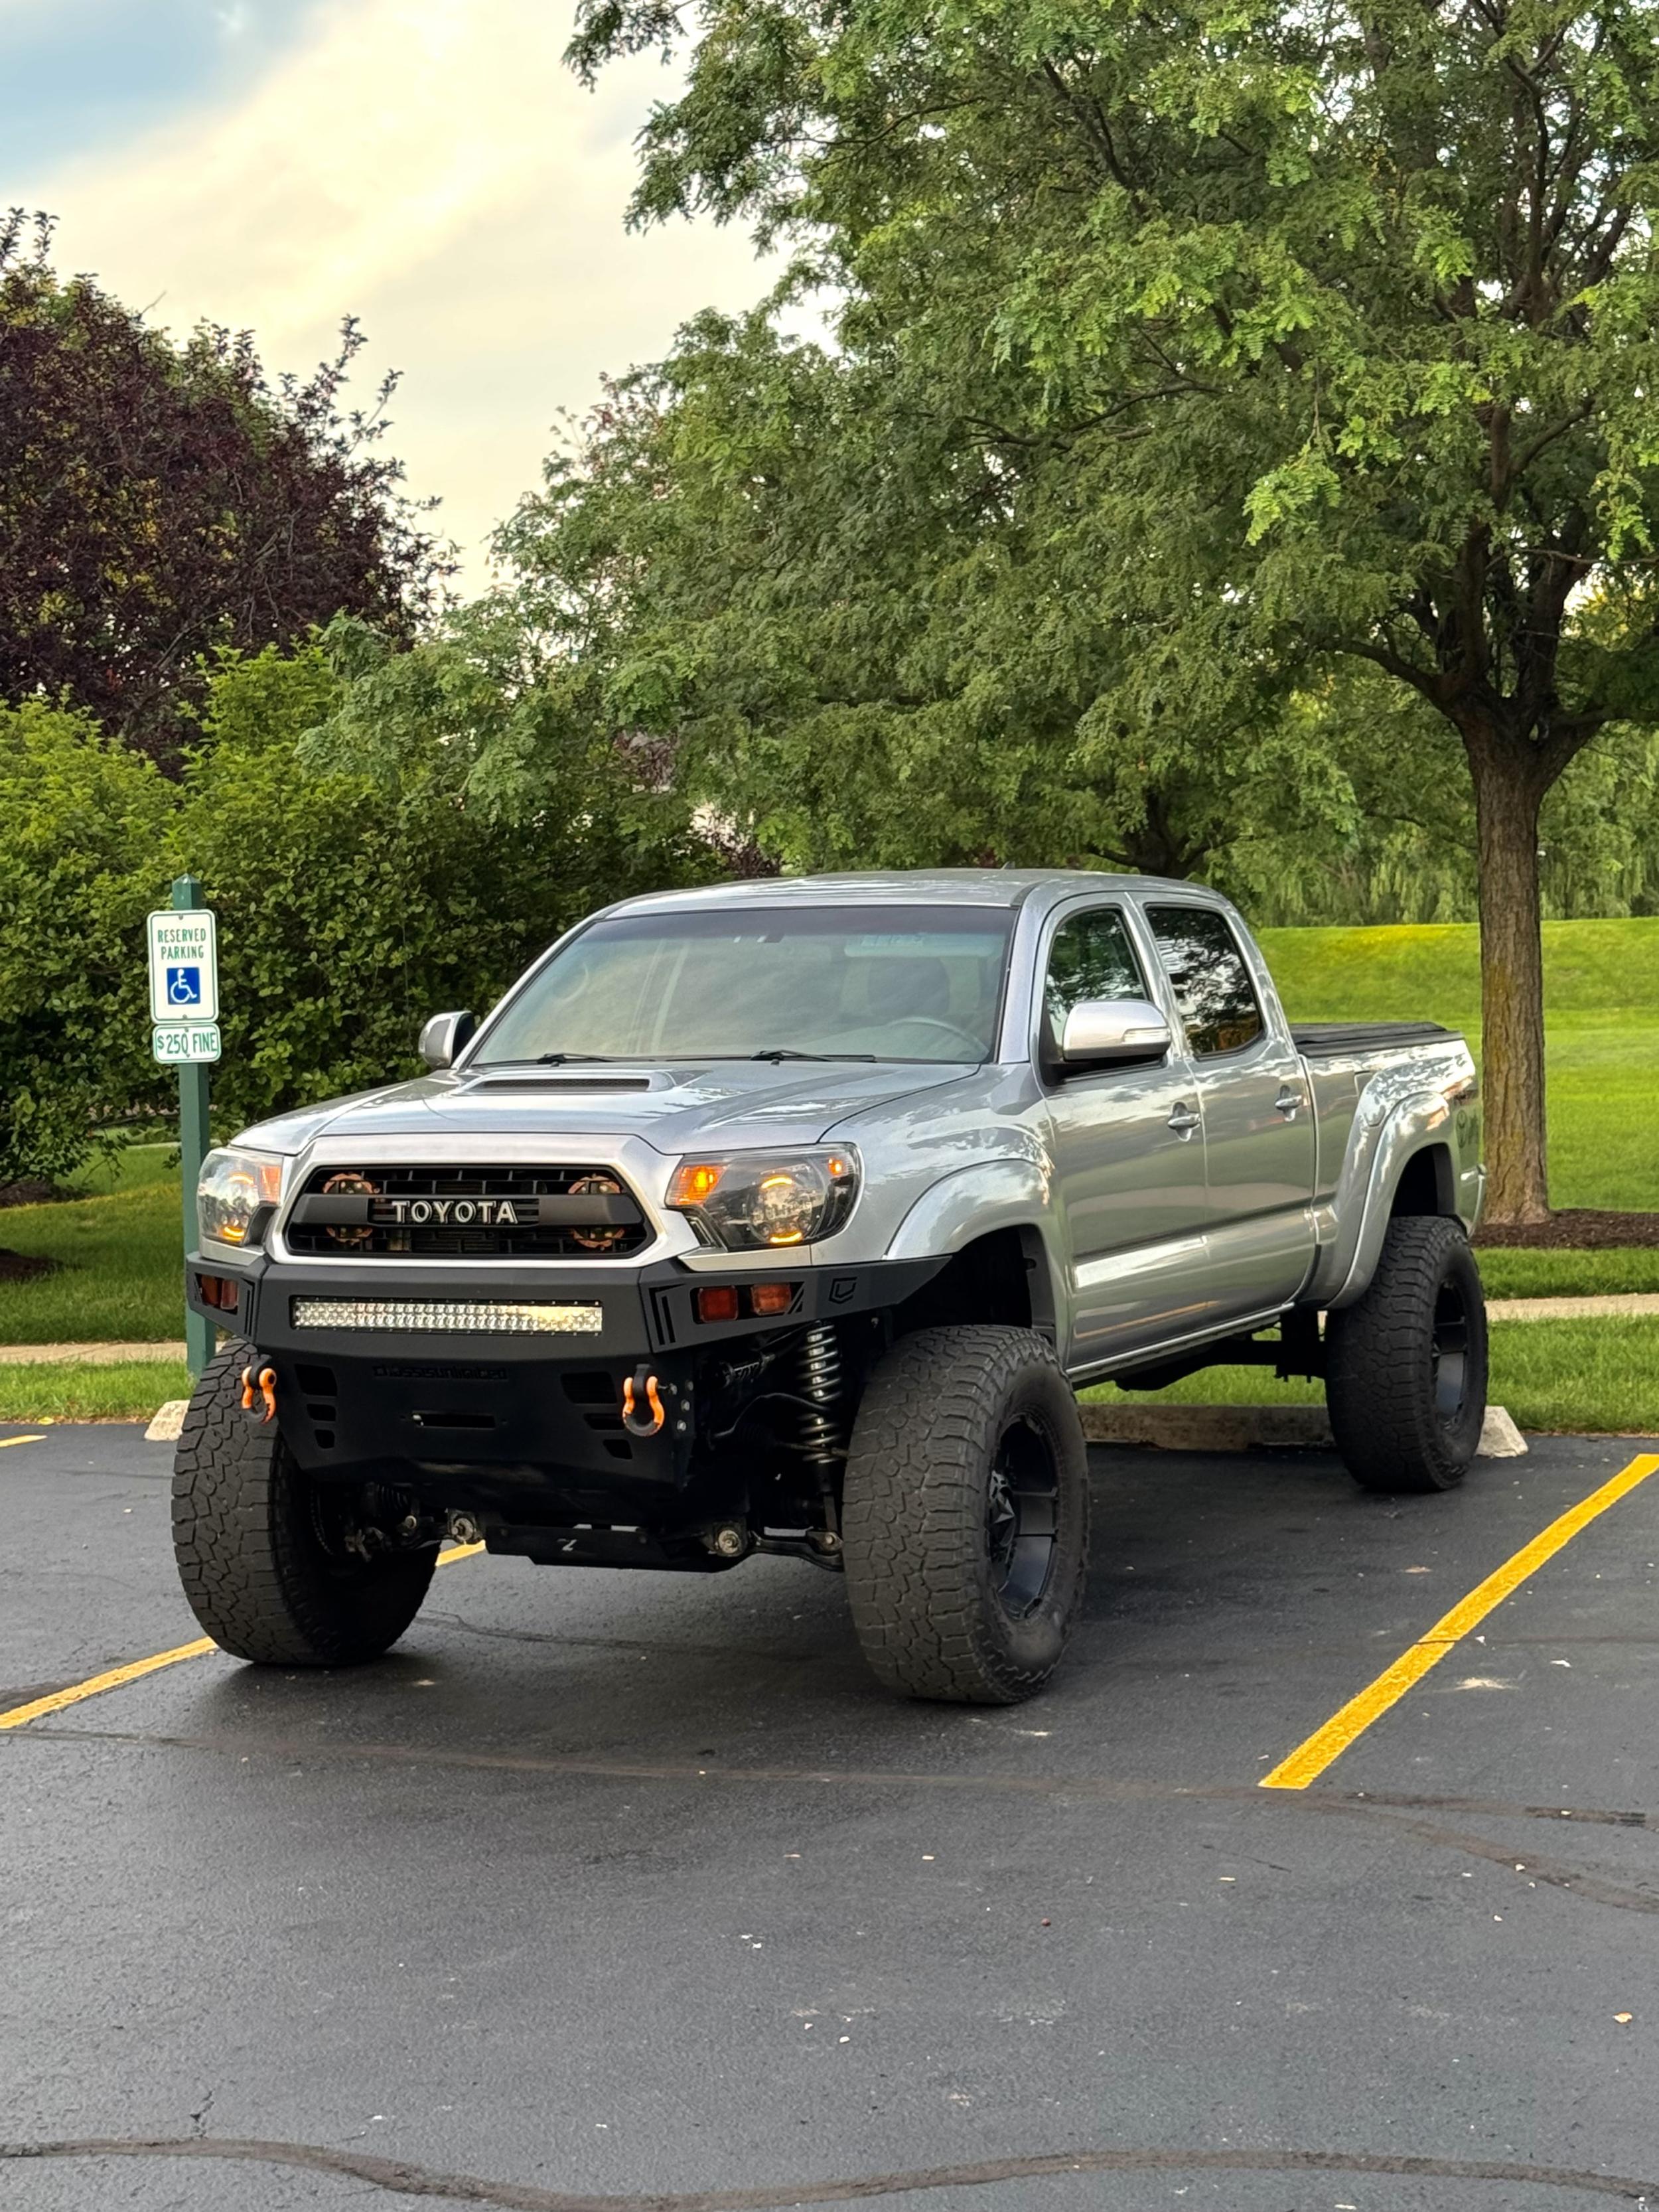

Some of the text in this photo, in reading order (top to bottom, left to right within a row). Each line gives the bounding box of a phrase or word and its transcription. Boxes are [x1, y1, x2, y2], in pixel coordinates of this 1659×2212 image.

[157, 928, 206, 943] RESERVED
[161, 945, 204, 960] PARKING
[157, 1032, 217, 1054] $250 FINE
[392, 1200, 519, 1224] TOYOTA
